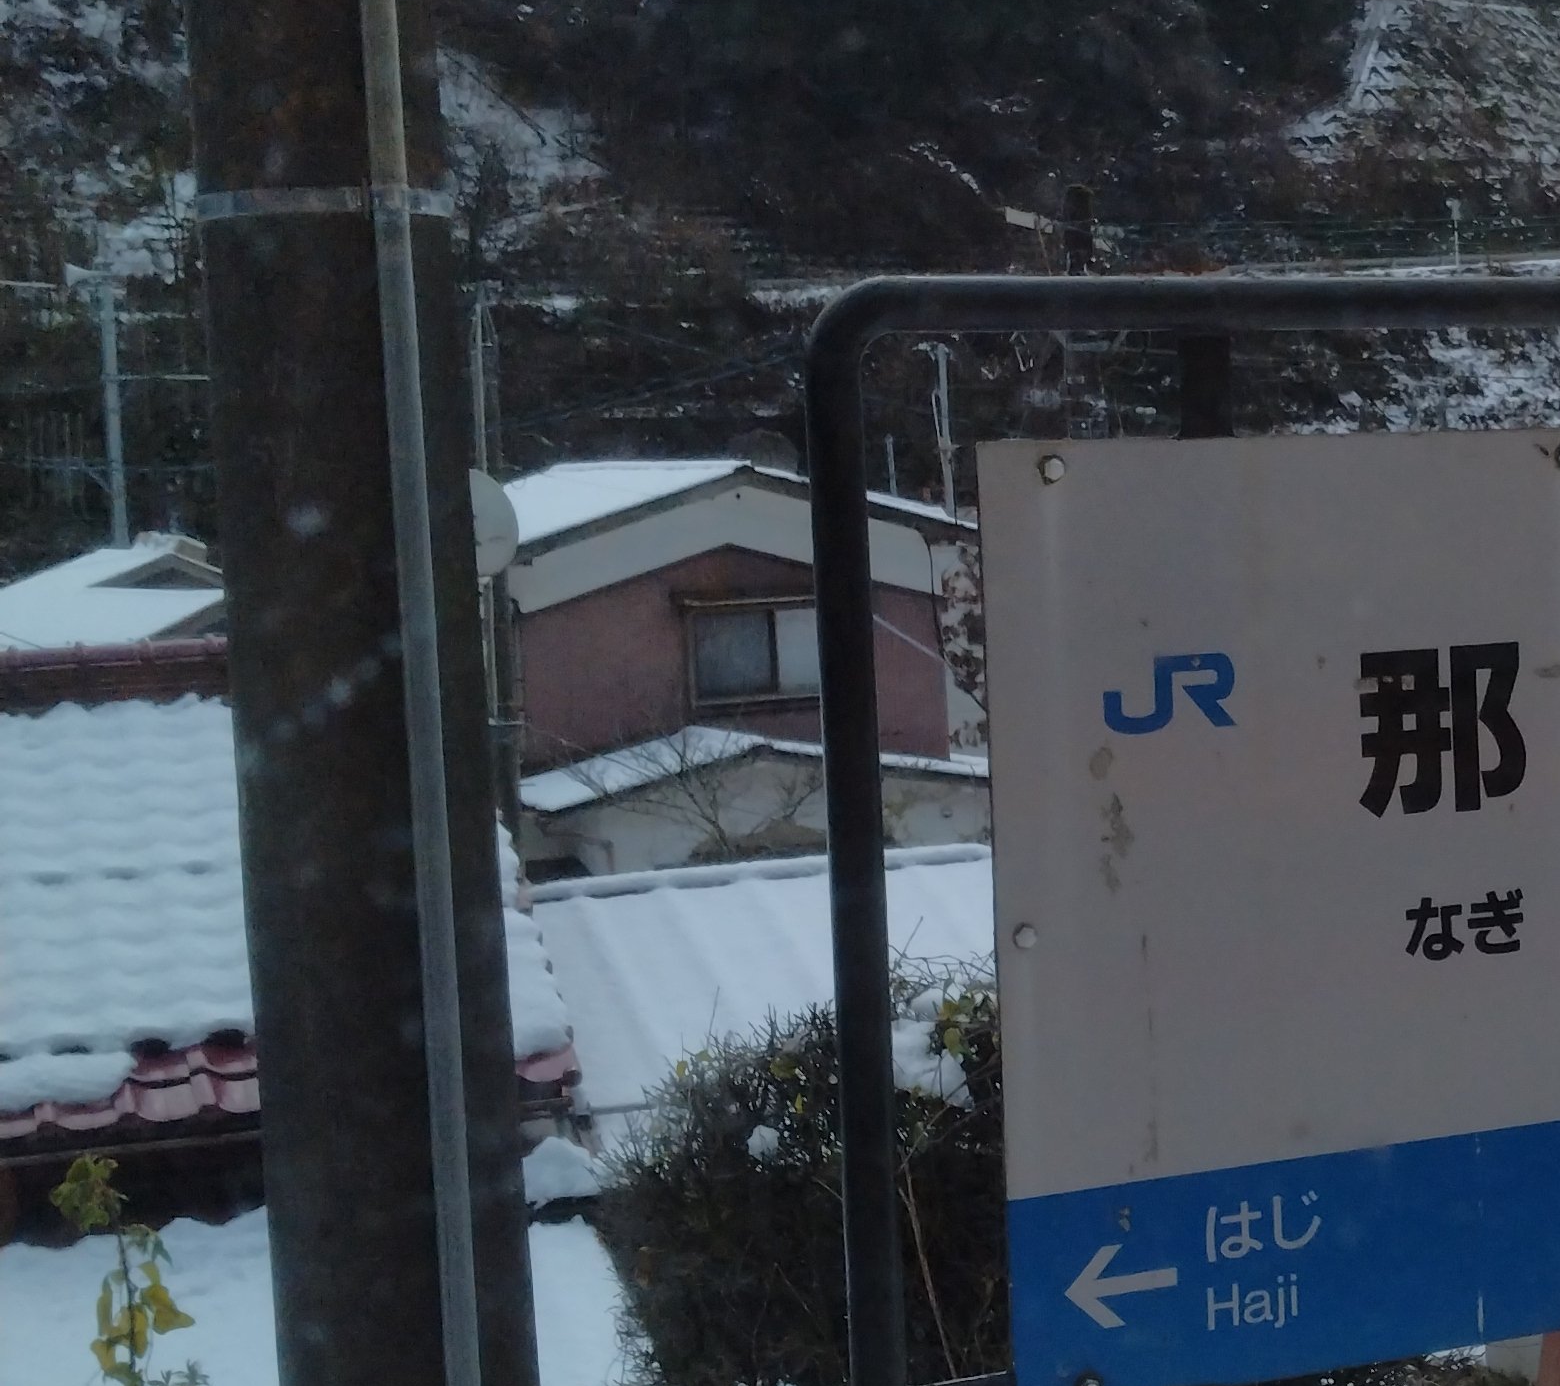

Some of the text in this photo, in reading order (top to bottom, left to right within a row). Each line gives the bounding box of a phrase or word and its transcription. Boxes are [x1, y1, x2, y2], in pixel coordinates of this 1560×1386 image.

[1102, 652, 1238, 735] JR
[1404, 887, 1524, 961] なぎ
[1205, 1189, 1323, 1263] はじ
[1206, 1273, 1299, 1331] Haji
